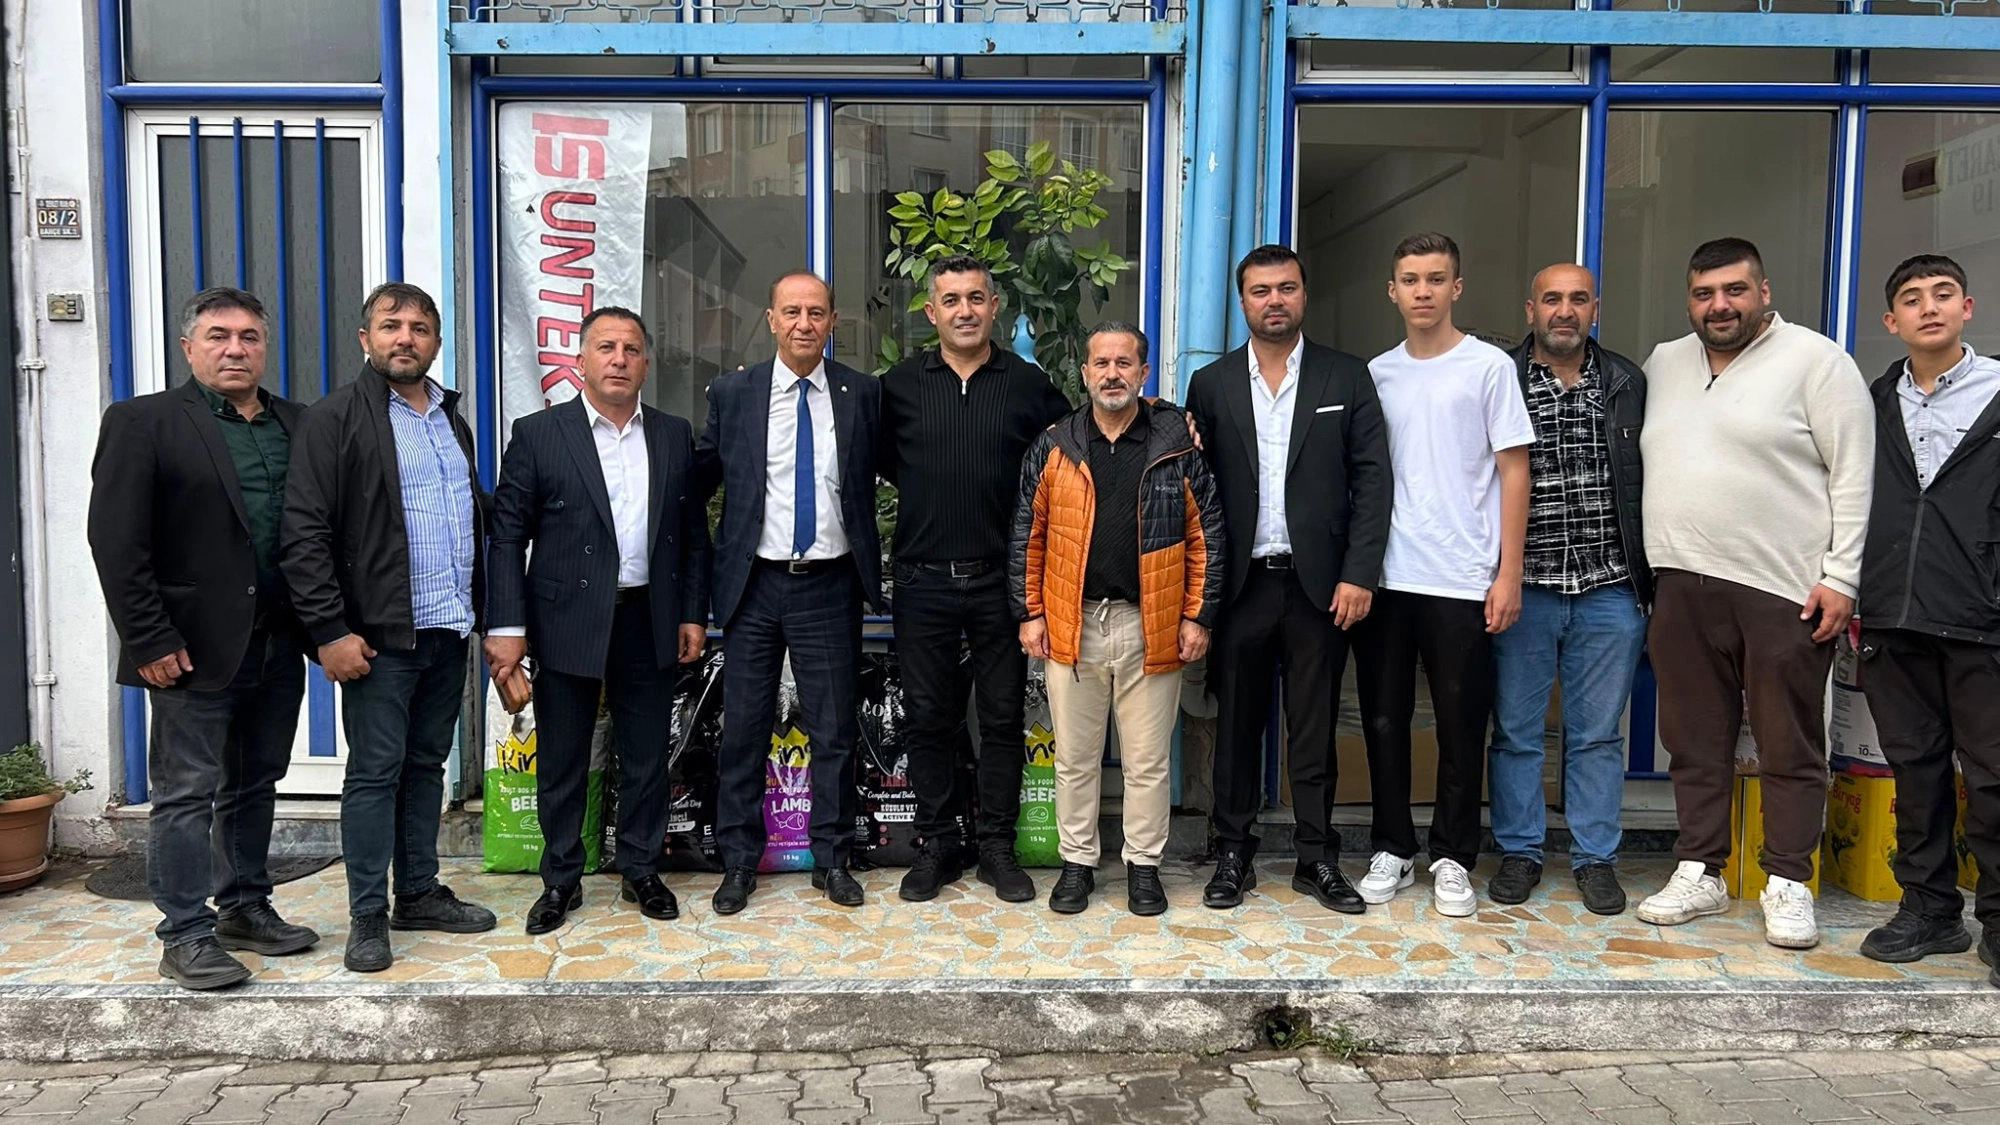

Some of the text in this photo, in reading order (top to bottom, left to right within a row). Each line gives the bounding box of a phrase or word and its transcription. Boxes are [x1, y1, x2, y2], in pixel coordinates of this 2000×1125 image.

[39, 210, 77, 225] 08/2
[511, 795, 537, 812] BEE
[771, 797, 812, 814] LAMB
[530, 844, 539, 853] kg
[791, 854, 800, 862] kg
